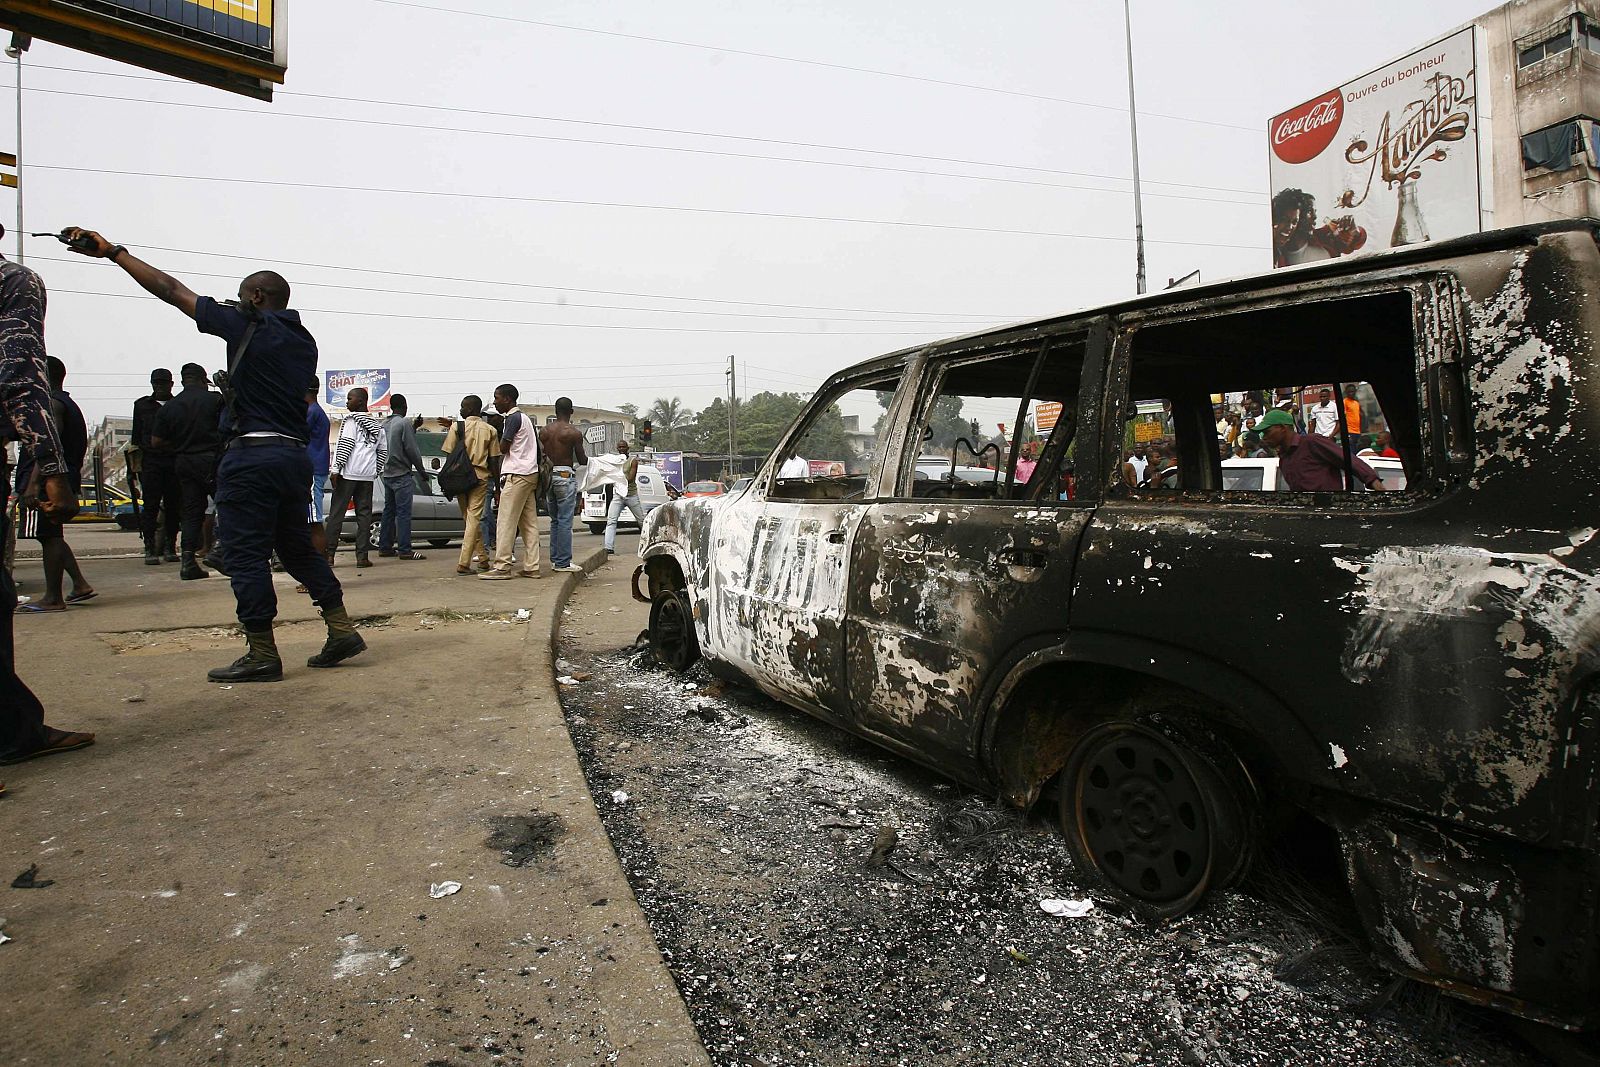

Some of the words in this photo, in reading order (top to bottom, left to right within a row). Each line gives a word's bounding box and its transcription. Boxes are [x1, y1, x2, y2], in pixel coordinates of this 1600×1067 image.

[1346, 83, 1378, 103] Ouvre
[1380, 76, 1395, 89] du
[1397, 52, 1447, 81] bonheur
[1274, 95, 1341, 145] Coca-Cola
[329, 375, 356, 389] CHAT
